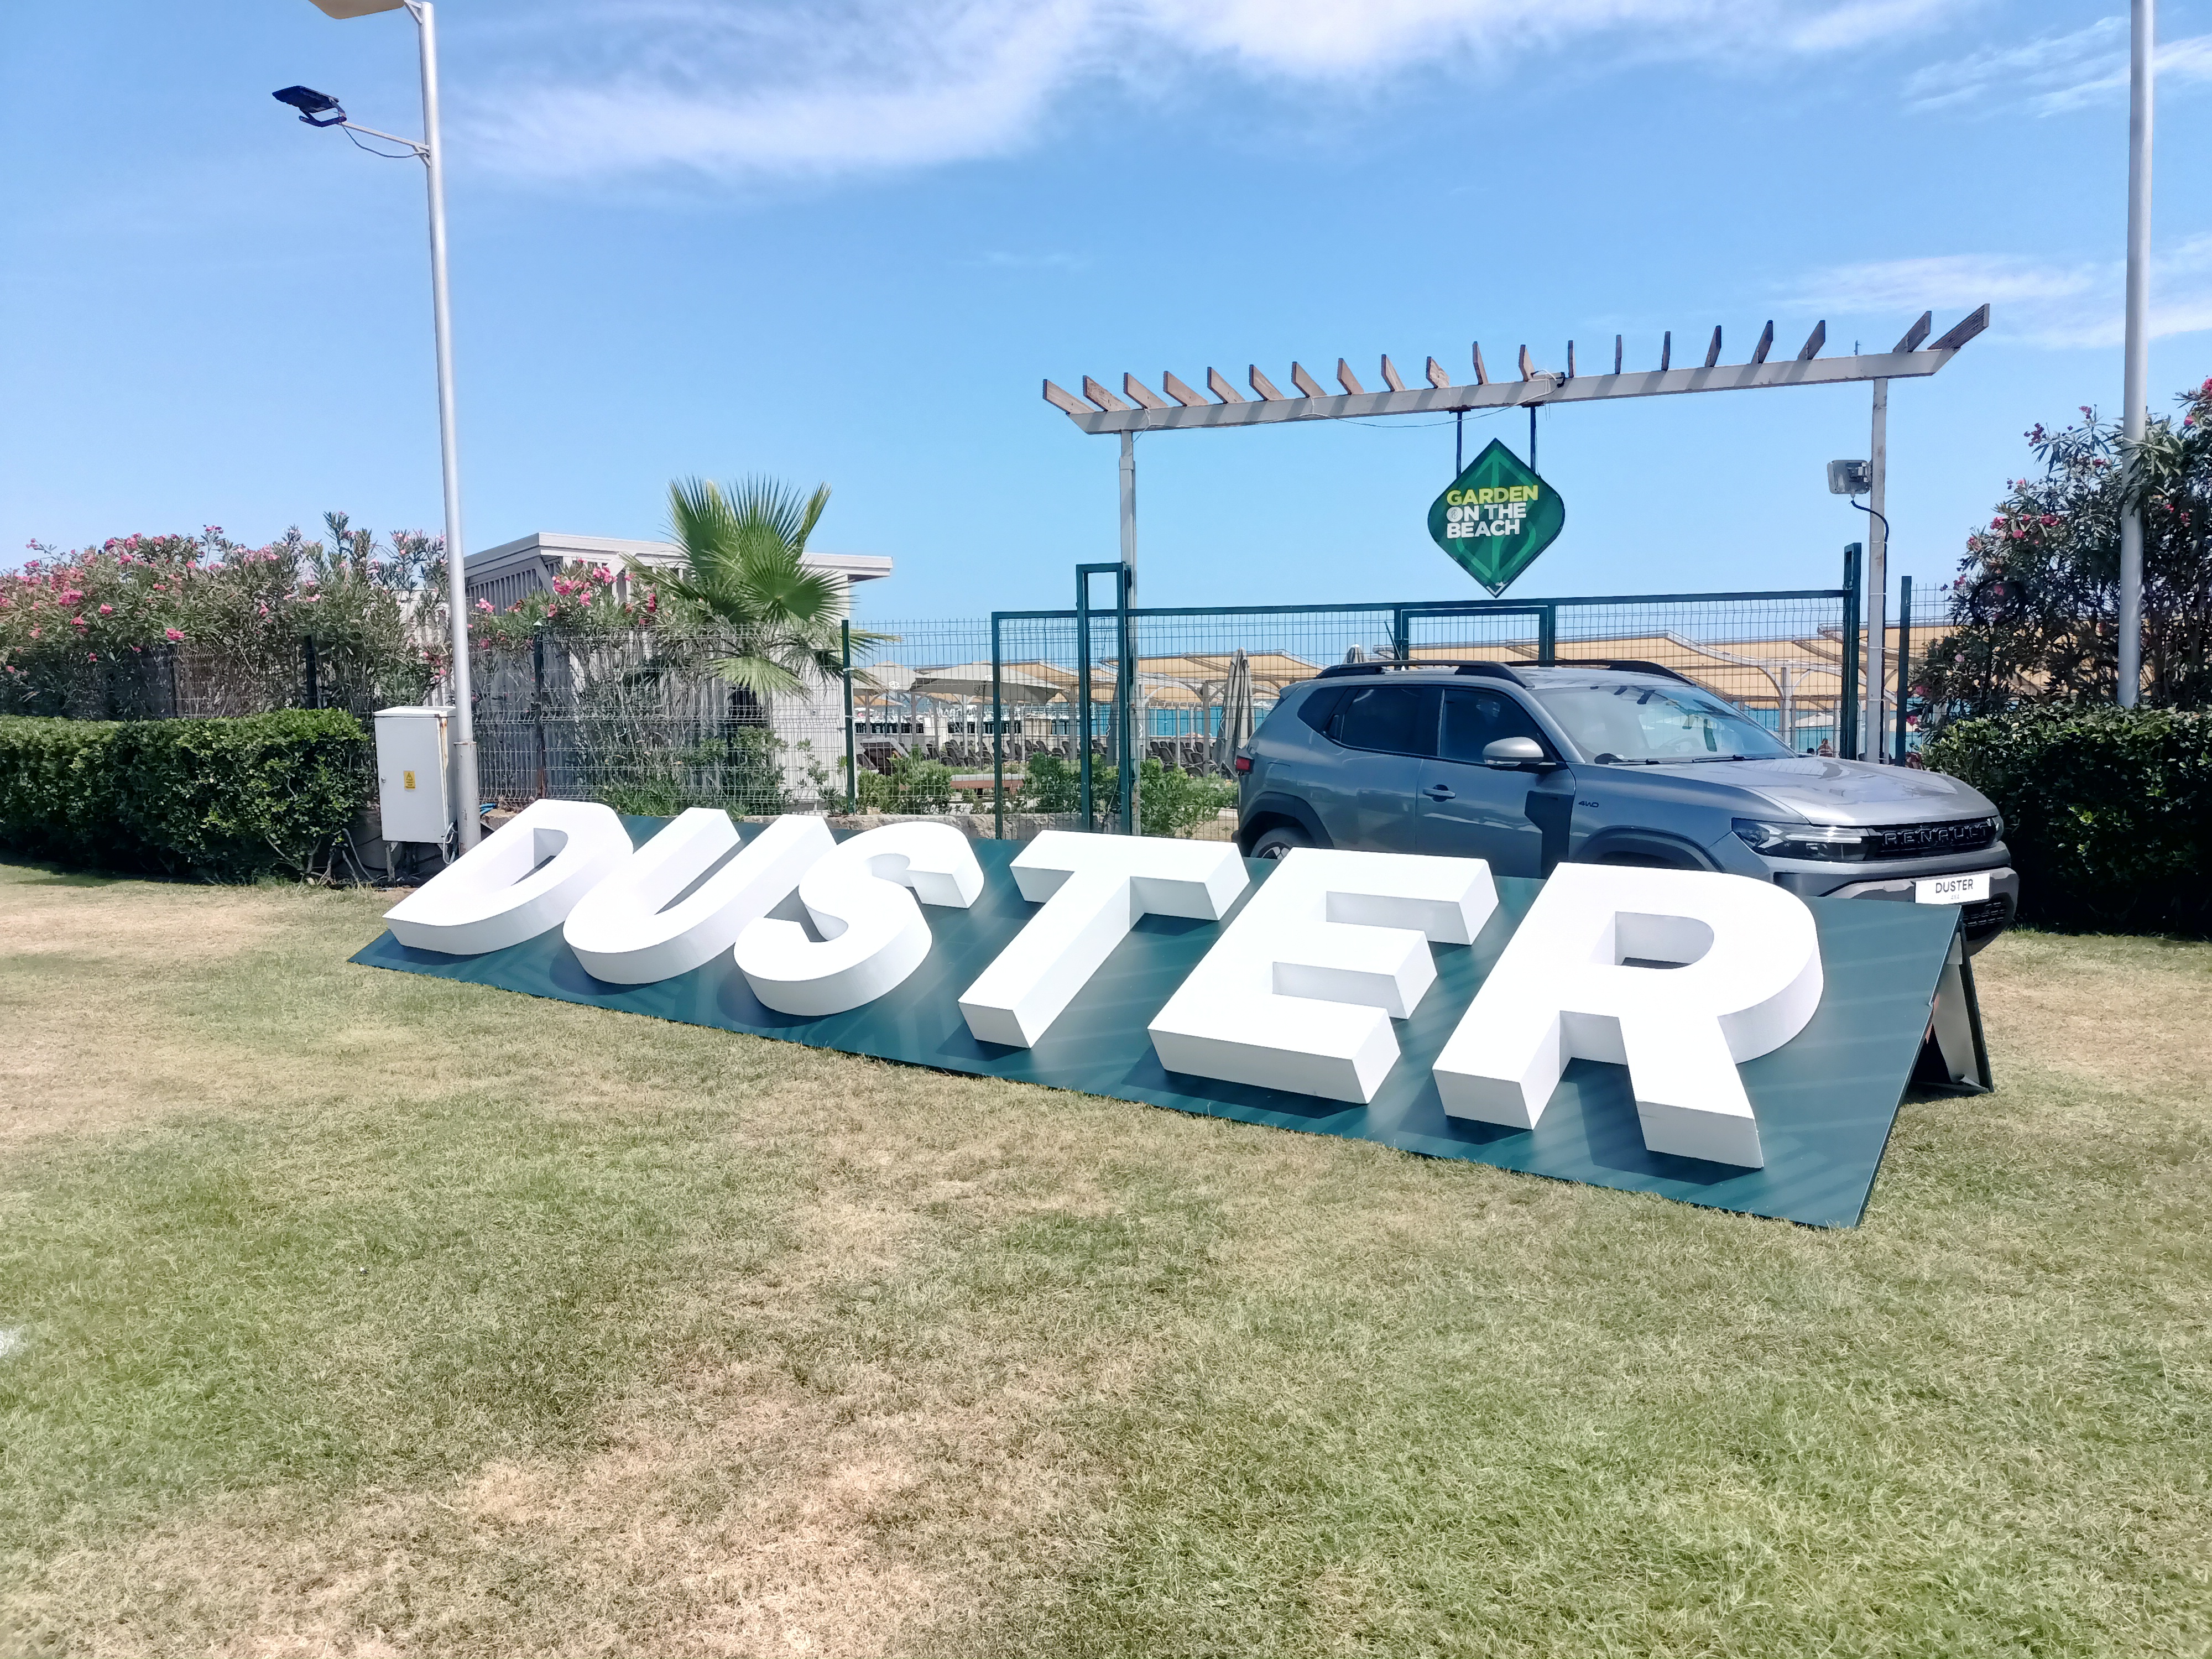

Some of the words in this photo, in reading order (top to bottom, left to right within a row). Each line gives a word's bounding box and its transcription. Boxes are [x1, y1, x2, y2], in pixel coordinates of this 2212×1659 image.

[1446, 485, 1538, 506] GARDEN
[1446, 505, 1479, 522] ON
[1484, 502, 1527, 520] THE
[1446, 519, 1520, 539] BEACH
[1884, 825, 1987, 846] RENAULT
[1936, 879, 1974, 894] DUSTER
[383, 798, 1825, 1171] DUSTER
